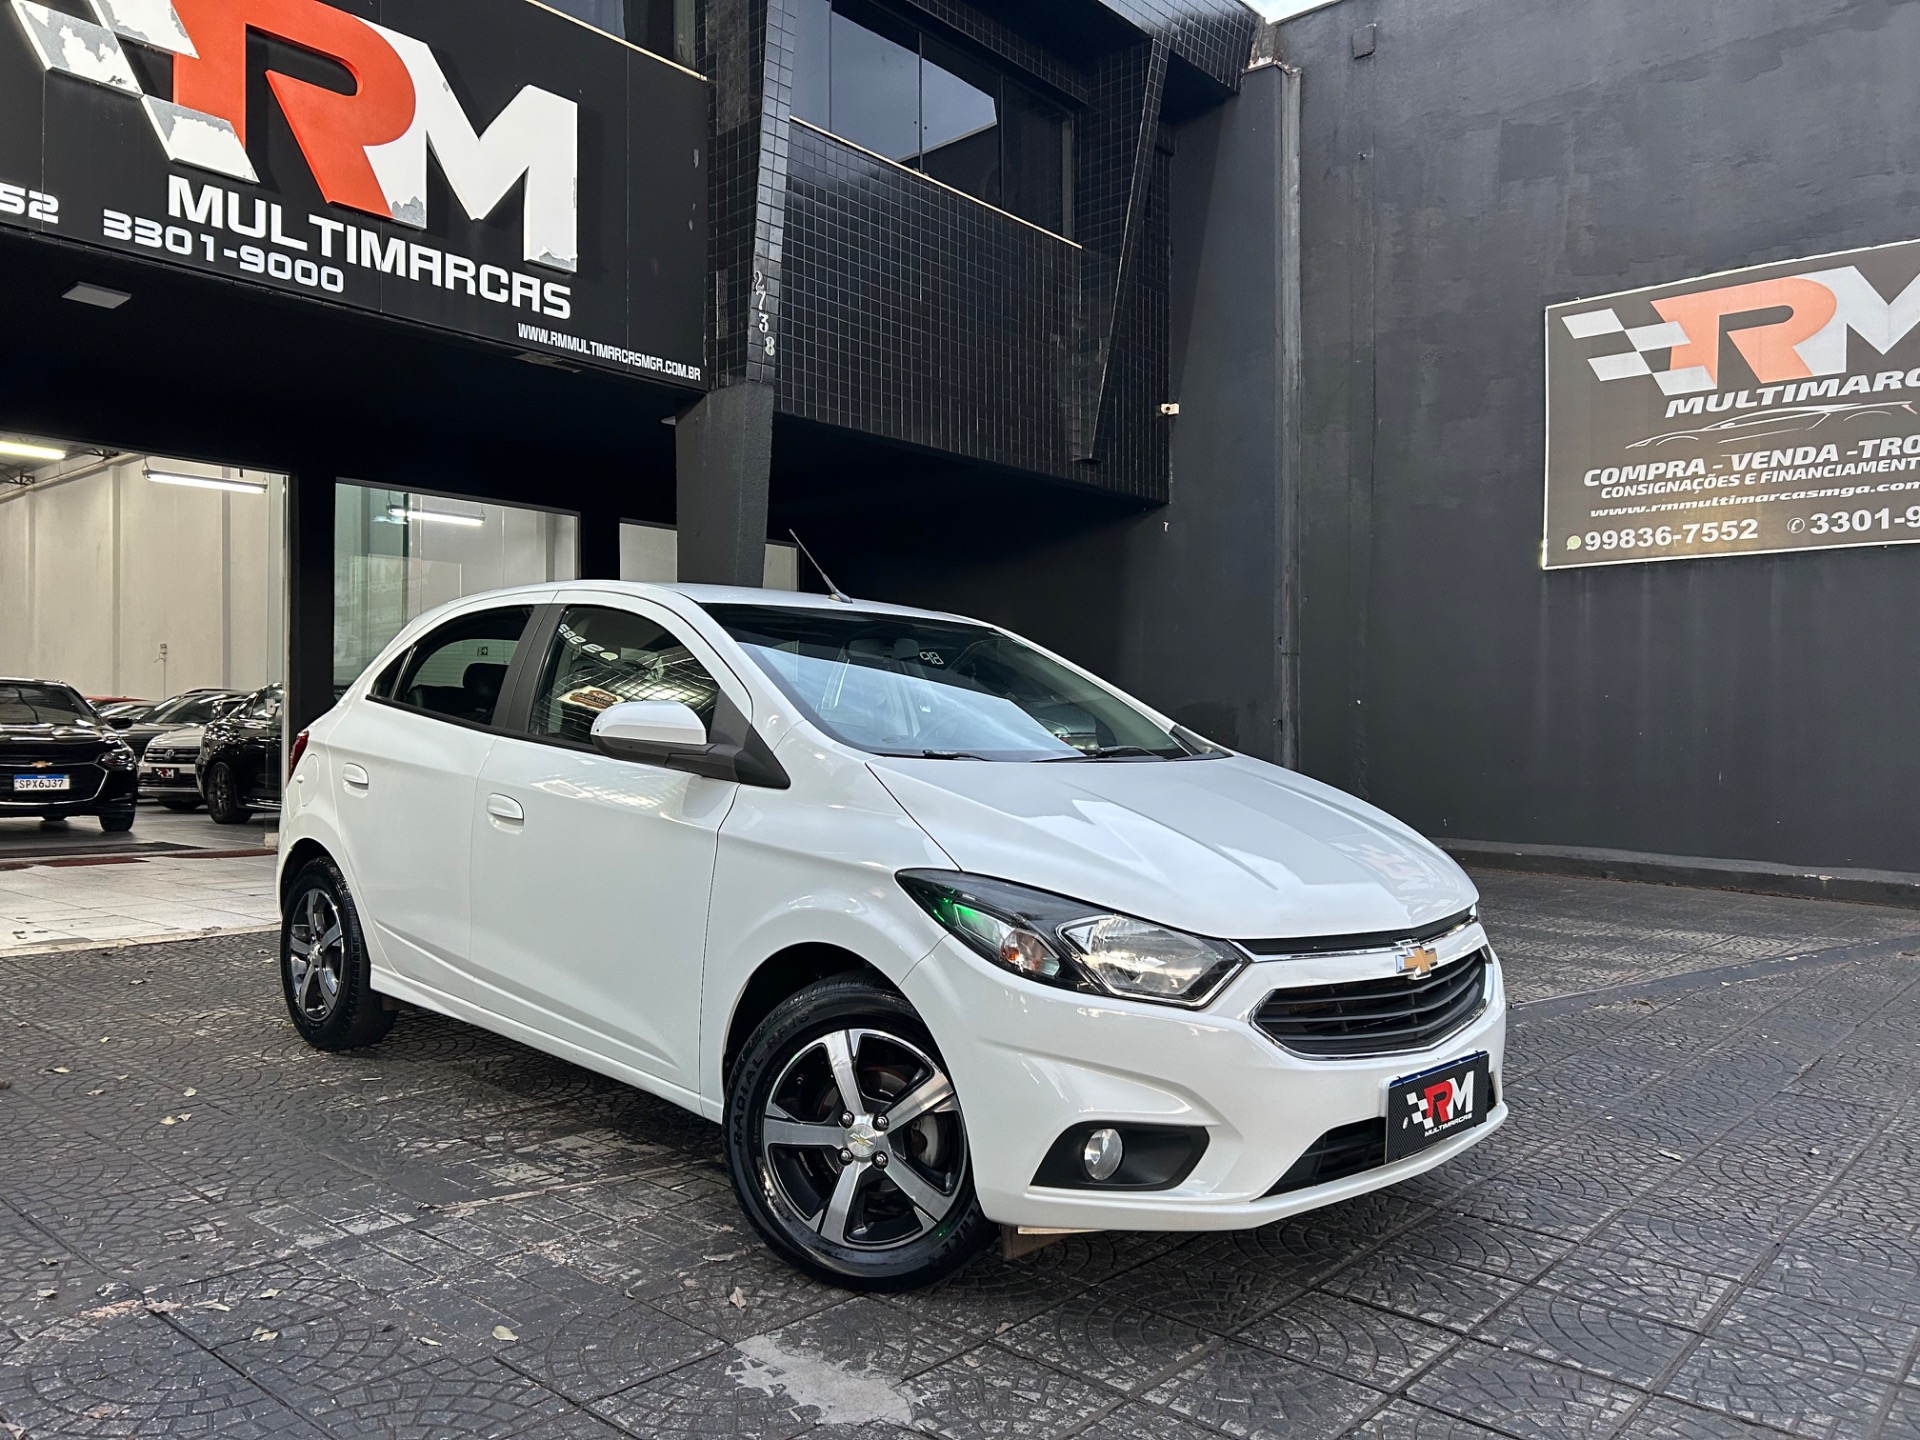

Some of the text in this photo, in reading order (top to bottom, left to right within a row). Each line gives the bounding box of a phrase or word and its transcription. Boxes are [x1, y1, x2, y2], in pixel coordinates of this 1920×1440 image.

[103, 208, 344, 293] 3301-9000
[168, 174, 571, 320] MULTIMARCAS
[753, 270, 776, 356] 2738
[517, 322, 701, 382] WWW.RMMULTIMARCASMGA.COM.BR
[1583, 457, 1707, 487] COMPRA
[1729, 443, 1839, 471] VENDA
[1601, 473, 1741, 499] CONSIGNAÇÕES
[1744, 472, 1757, 486] E
[1584, 505, 1920, 551] 99836-7552 3301-9
[18, 779, 64, 789] SPX6J37
